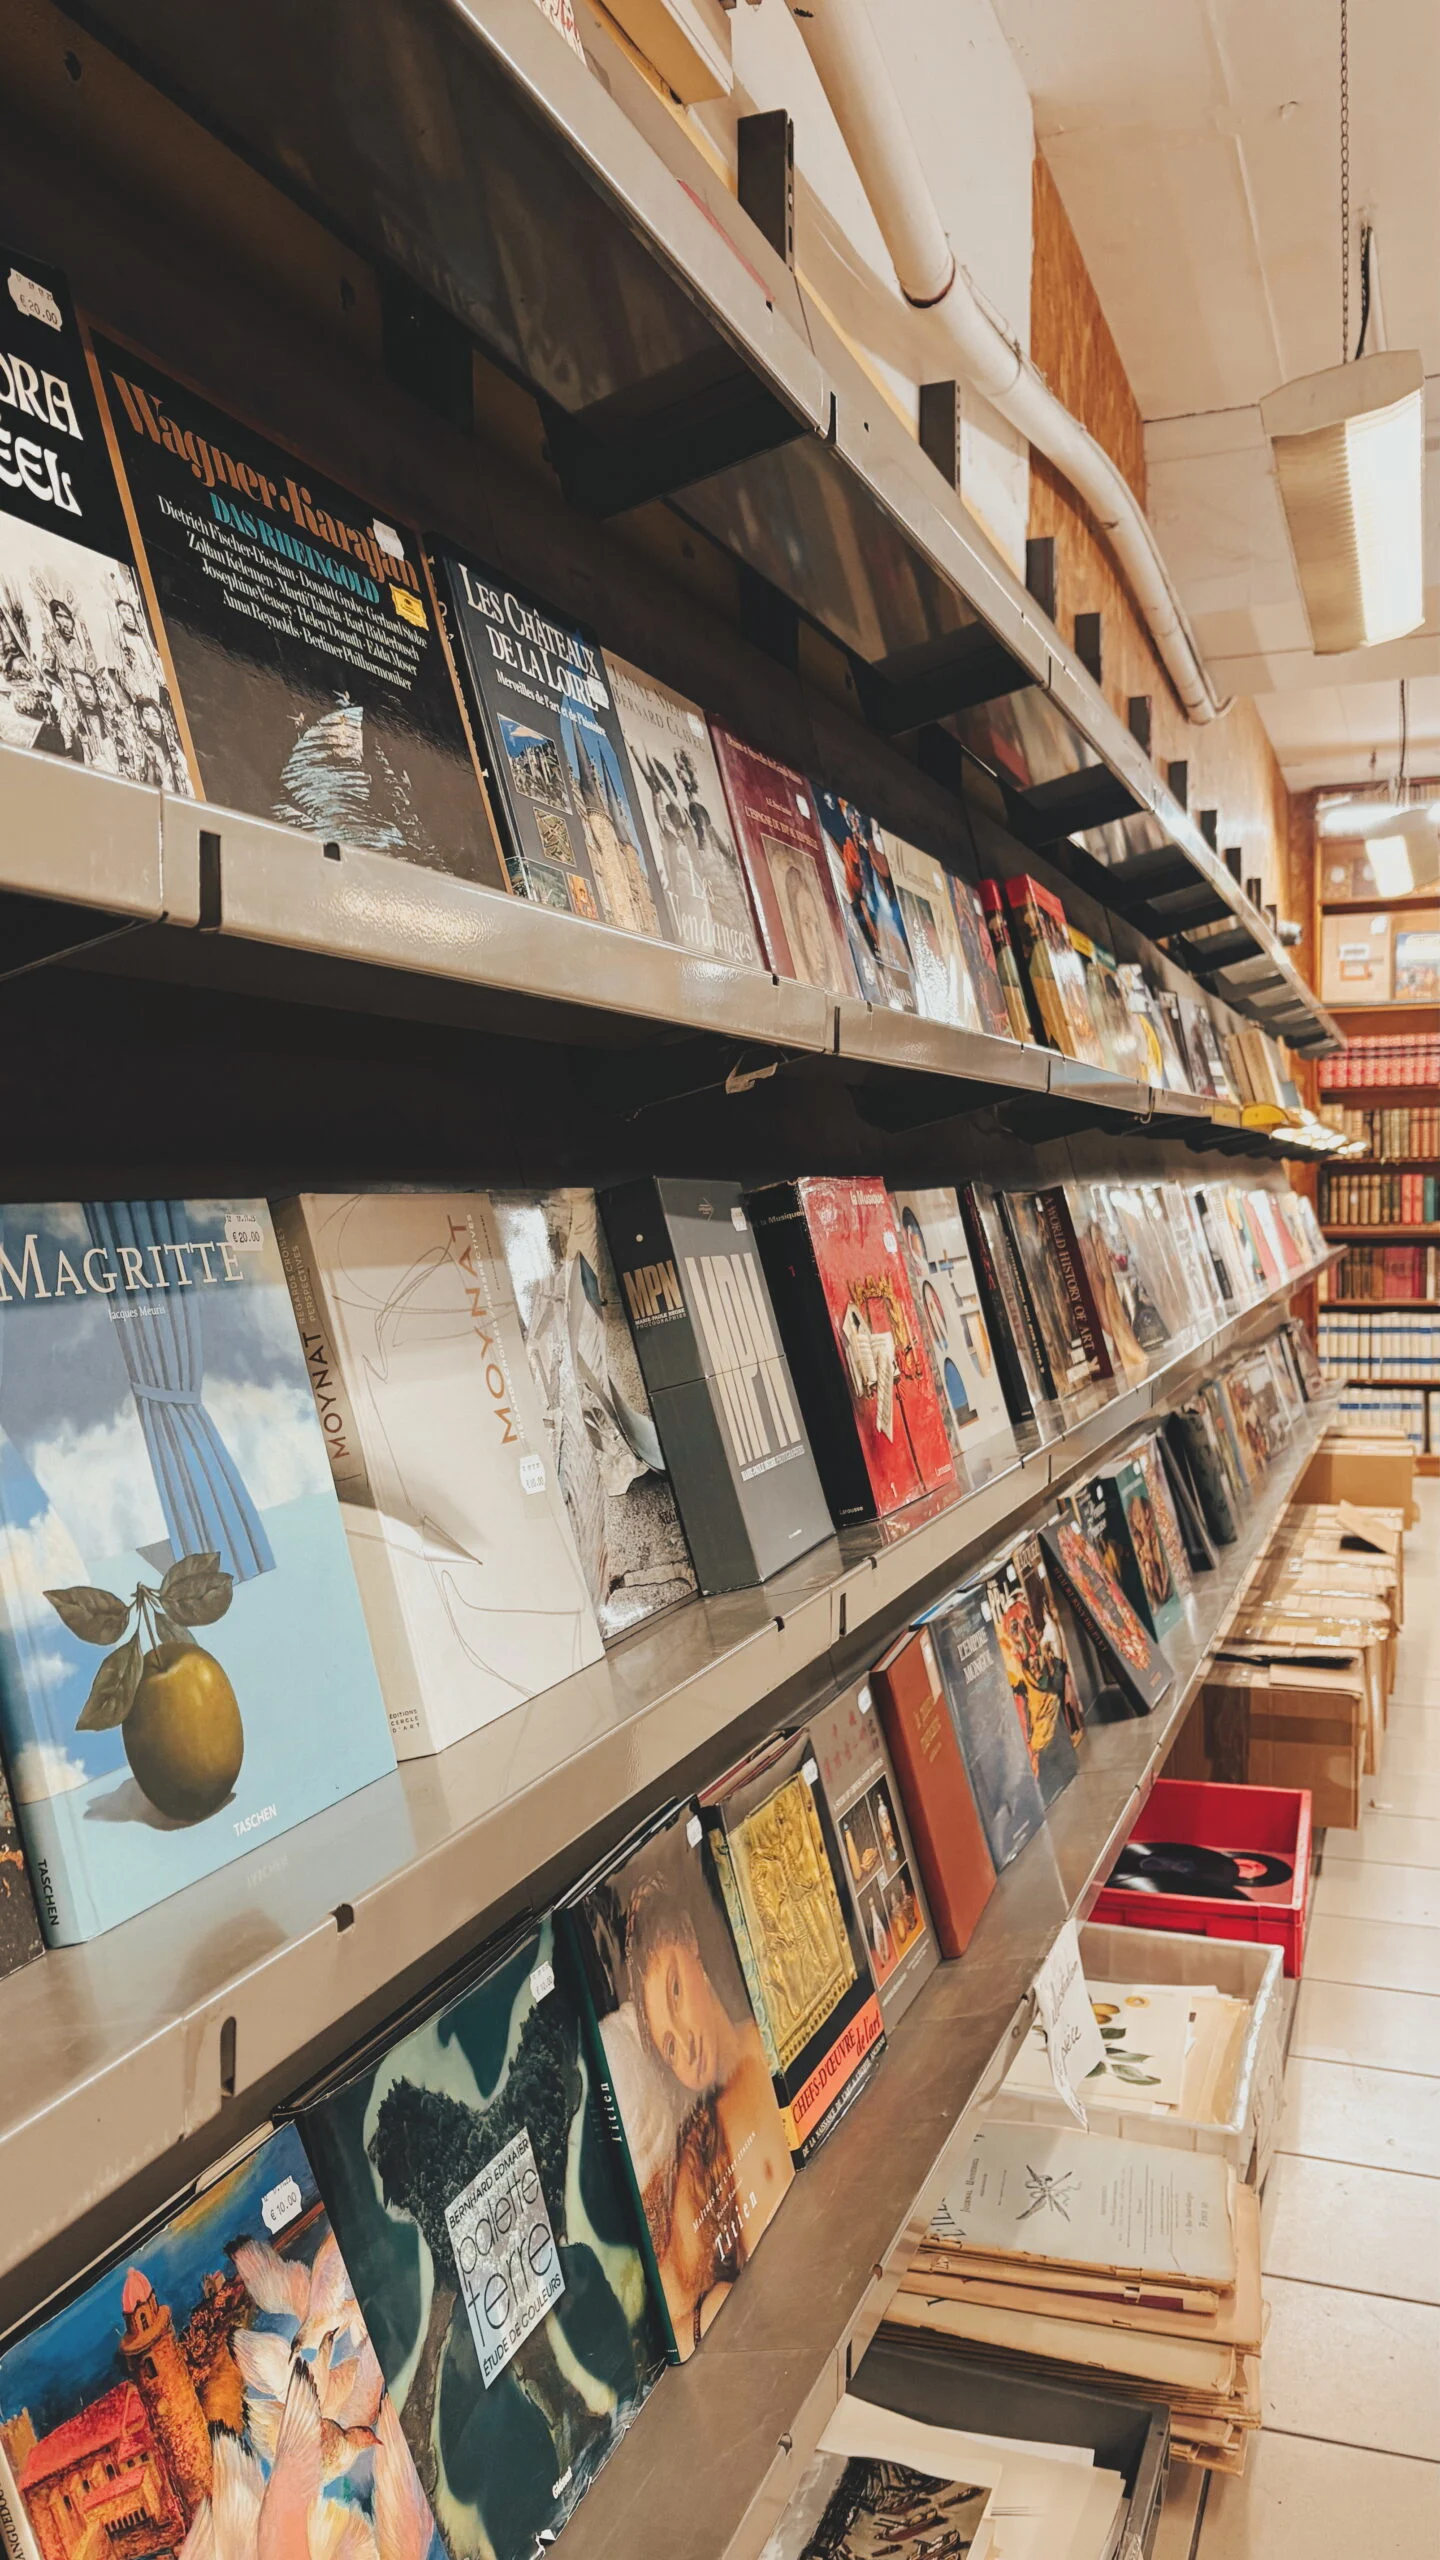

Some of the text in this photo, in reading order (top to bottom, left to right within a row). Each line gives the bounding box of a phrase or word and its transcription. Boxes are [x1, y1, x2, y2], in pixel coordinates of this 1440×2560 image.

[157, 494, 211, 536] Dietrich
[207, 520, 296, 581] Fischer-Dieskau
[299, 570, 336, 606] Donald
[365, 605, 401, 635] Gerhard
[209, 492, 380, 604] DAS RHEINGOLD
[187, 530, 226, 565] Zoltan
[224, 550, 275, 589] Kelemen
[276, 576, 311, 607] Martti
[344, 611, 366, 635] Karl
[365, 619, 420, 662] Ridderbusch
[202, 557, 418, 677] Josephine Veasey Helen Donath Edda Moser
[458, 563, 505, 625] LES
[223, 589, 412, 691] Anna Reynolds Berliner Philharmoniker
[486, 624, 518, 669] DE
[515, 642, 546, 684] LA
[495, 668, 536, 700] Merveilles
[534, 690, 545, 705] de
[612, 684, 664, 728] BERNARD
[667, 886, 753, 963] Vendanges
[232, 1231, 260, 1243] €20.00
[768, 1210, 804, 1223] Musique
[1047, 1206, 1067, 1249] WORLD
[0, 1234, 244, 1301] MAGRITTE
[287, 1274, 305, 1325] REGARDS
[293, 1245, 316, 1323] PERSPECTIVES
[623, 1260, 684, 1321] MPN
[1058, 1250, 1082, 1304] HISTORY
[108, 1303, 166, 1321] Jacques Meuris
[447, 1214, 518, 1445] MOYNAT
[1074, 1306, 1087, 1322] OF
[1079, 1326, 1095, 1351] ART
[302, 1330, 350, 1460] MOYNAT
[890, 1482, 898, 1499] 1
[232, 1803, 277, 1837] TASCHEN
[38, 1858, 59, 1927] TASCHEN
[792, 2027, 857, 2124] CHEFS-D'ŒUVRE
[855, 2027, 866, 2057] de
[864, 2009, 882, 2039] l'art
[600, 2081, 623, 2143] Titien
[270, 2191, 297, 2221] €10.00
[448, 2138, 530, 2230] BERNHARD EDMAIER
[456, 2168, 540, 2292] palette
[715, 2191, 758, 2262] Titien
[467, 2223, 553, 2347] terre
[482, 2273, 563, 2378] ÉTUDE DE COULEURS
